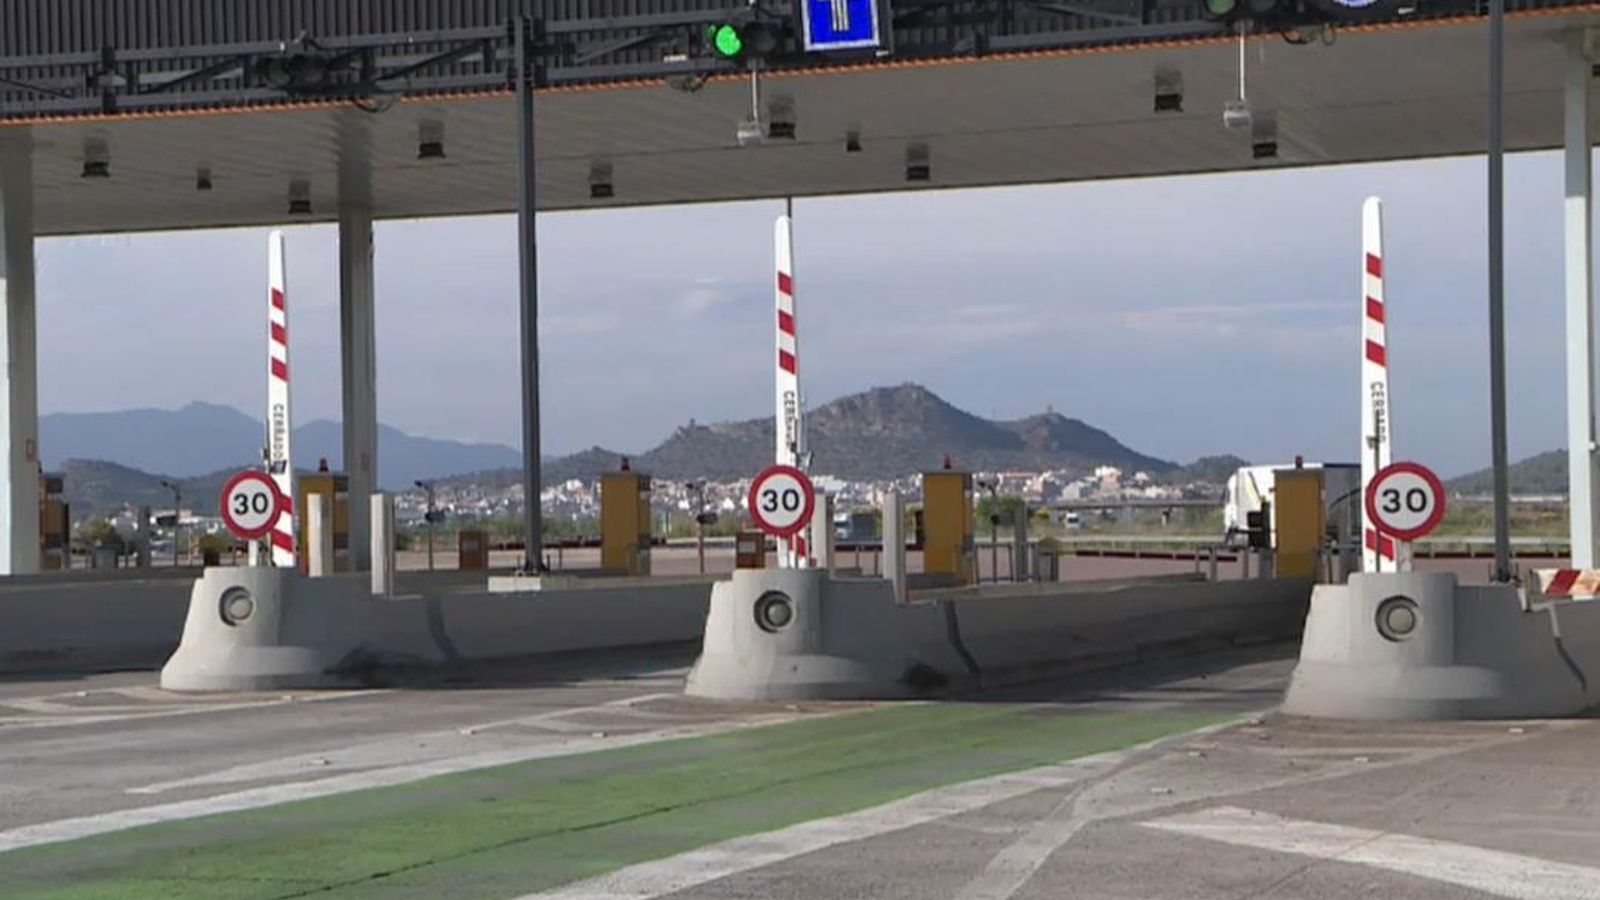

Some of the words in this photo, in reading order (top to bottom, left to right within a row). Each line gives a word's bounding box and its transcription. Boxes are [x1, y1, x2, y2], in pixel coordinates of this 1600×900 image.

[233, 492, 269, 516] 30
[762, 489, 800, 513] 30
[1381, 488, 1427, 513] 30
